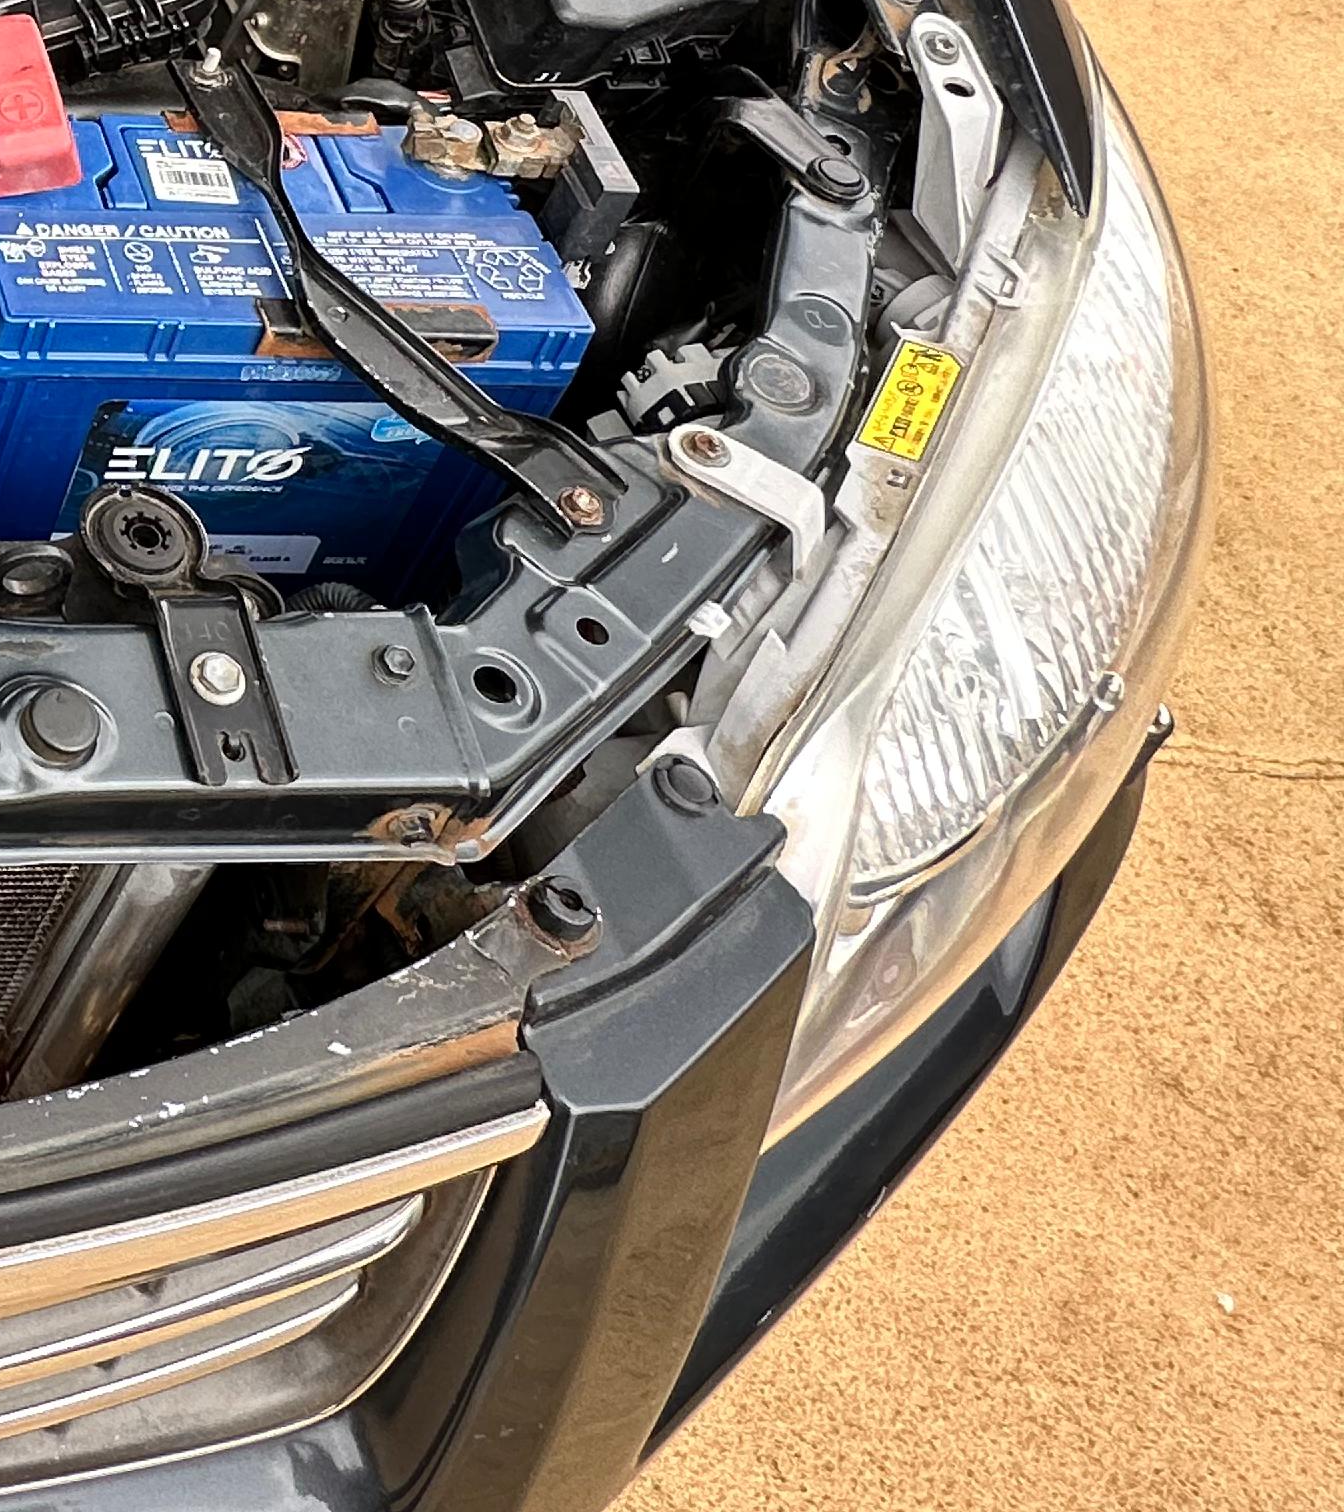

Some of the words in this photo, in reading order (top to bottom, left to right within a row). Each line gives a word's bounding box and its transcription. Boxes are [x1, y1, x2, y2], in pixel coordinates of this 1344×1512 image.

[34, 223, 120, 238] DANGER
[124, 224, 136, 238] /
[138, 226, 231, 239] CAUTION
